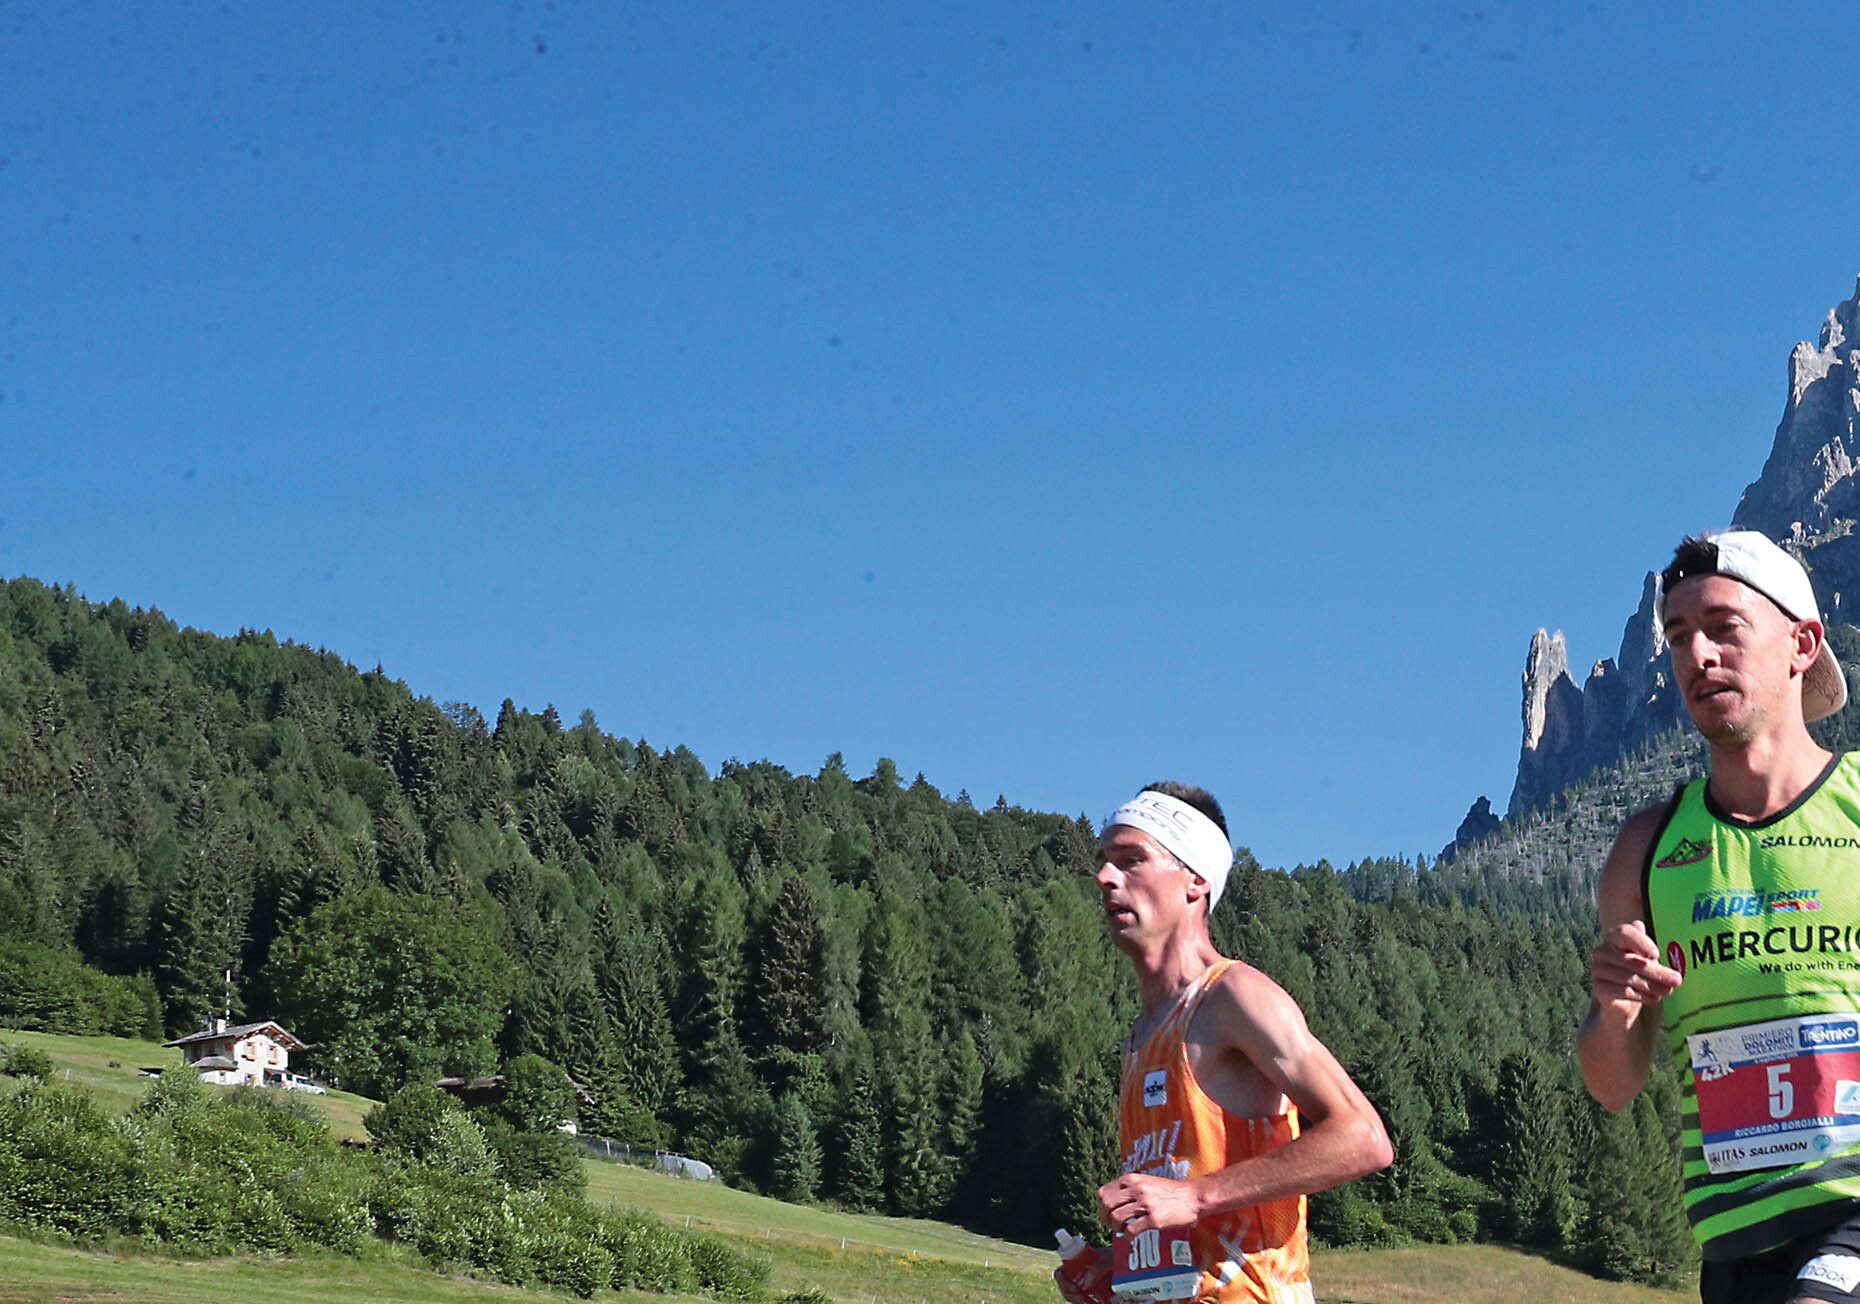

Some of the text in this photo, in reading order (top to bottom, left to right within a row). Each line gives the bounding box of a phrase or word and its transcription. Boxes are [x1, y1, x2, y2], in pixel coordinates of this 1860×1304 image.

[1692, 889, 1820, 923] MAPEI SPORT
[1759, 963, 1782, 974] We
[1785, 961, 1802, 973] do
[1807, 960, 1834, 972] with
[1766, 1063, 1794, 1119] 5
[1734, 1117, 1834, 1138] RICCARDO BORGIALLI
[1749, 1141, 1808, 1157] SALOMON
[1128, 1229, 1161, 1271] 310
